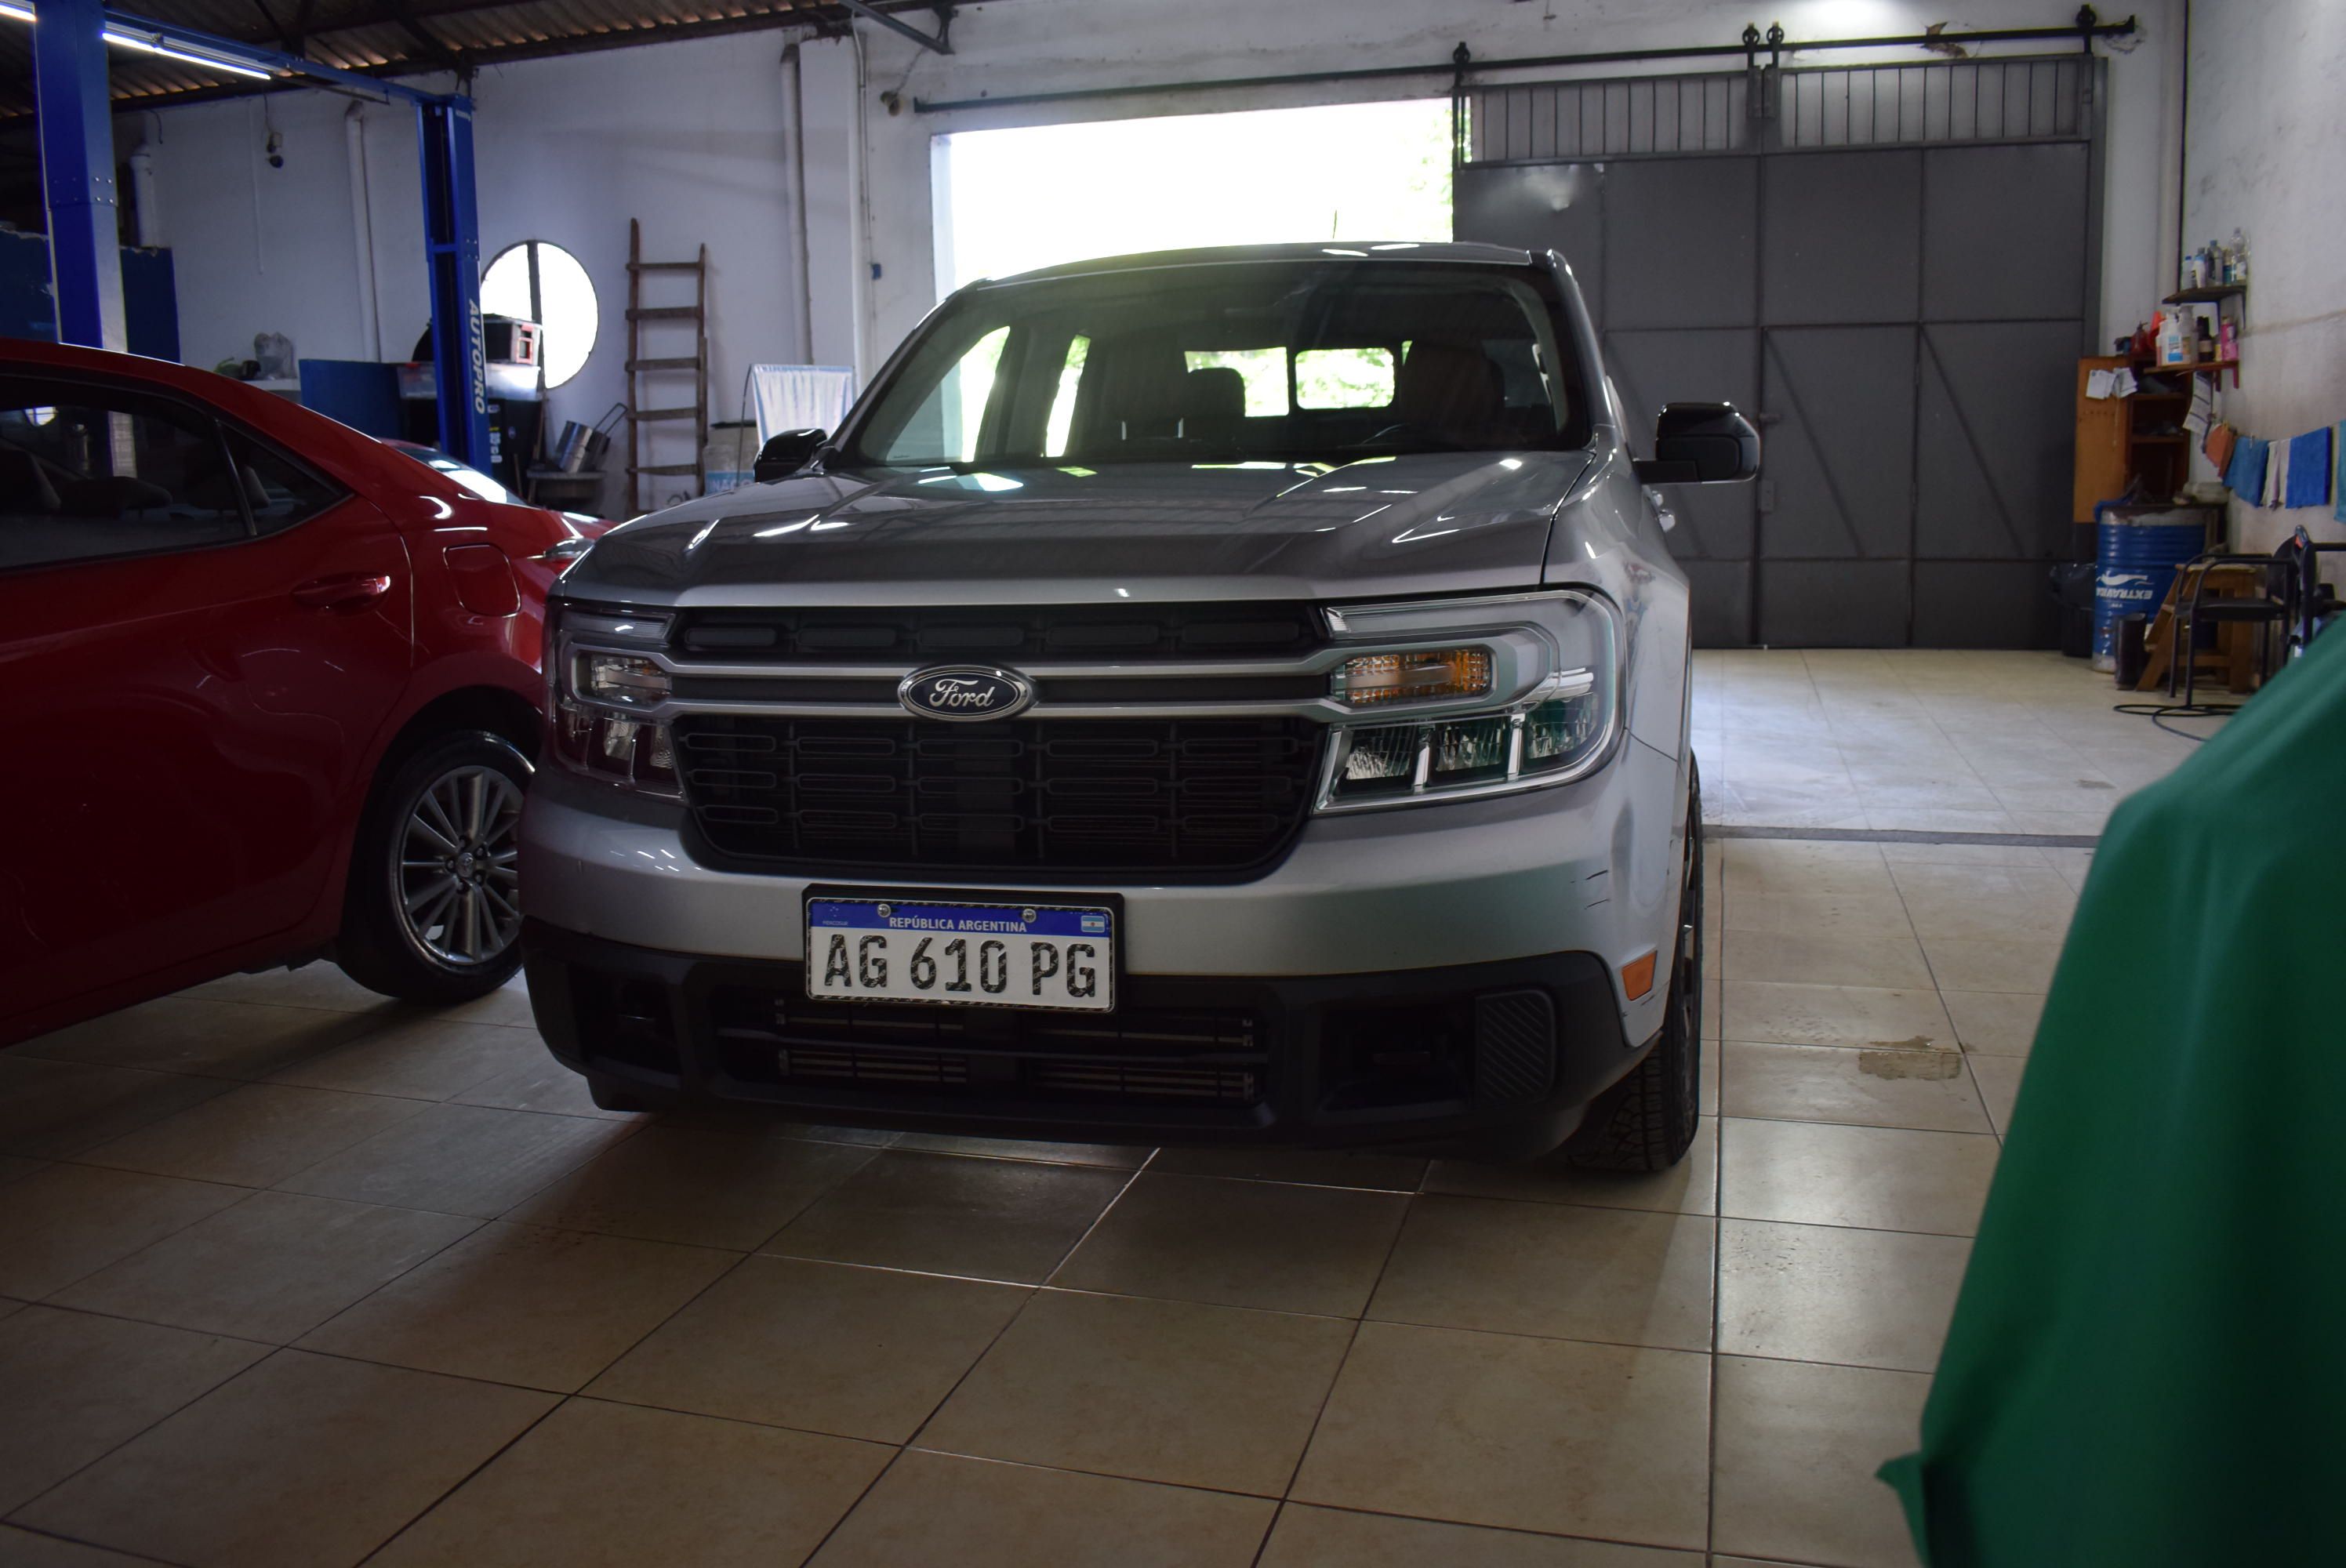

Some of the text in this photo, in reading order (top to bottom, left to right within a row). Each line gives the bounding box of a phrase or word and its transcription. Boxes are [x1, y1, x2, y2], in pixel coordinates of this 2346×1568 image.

[468, 299, 485, 415] AUTOPRO
[928, 678, 996, 707] Ford
[889, 915, 1027, 933] REPÚBLICA ARGENTINA
[824, 934, 1096, 998] AG 610 PG
